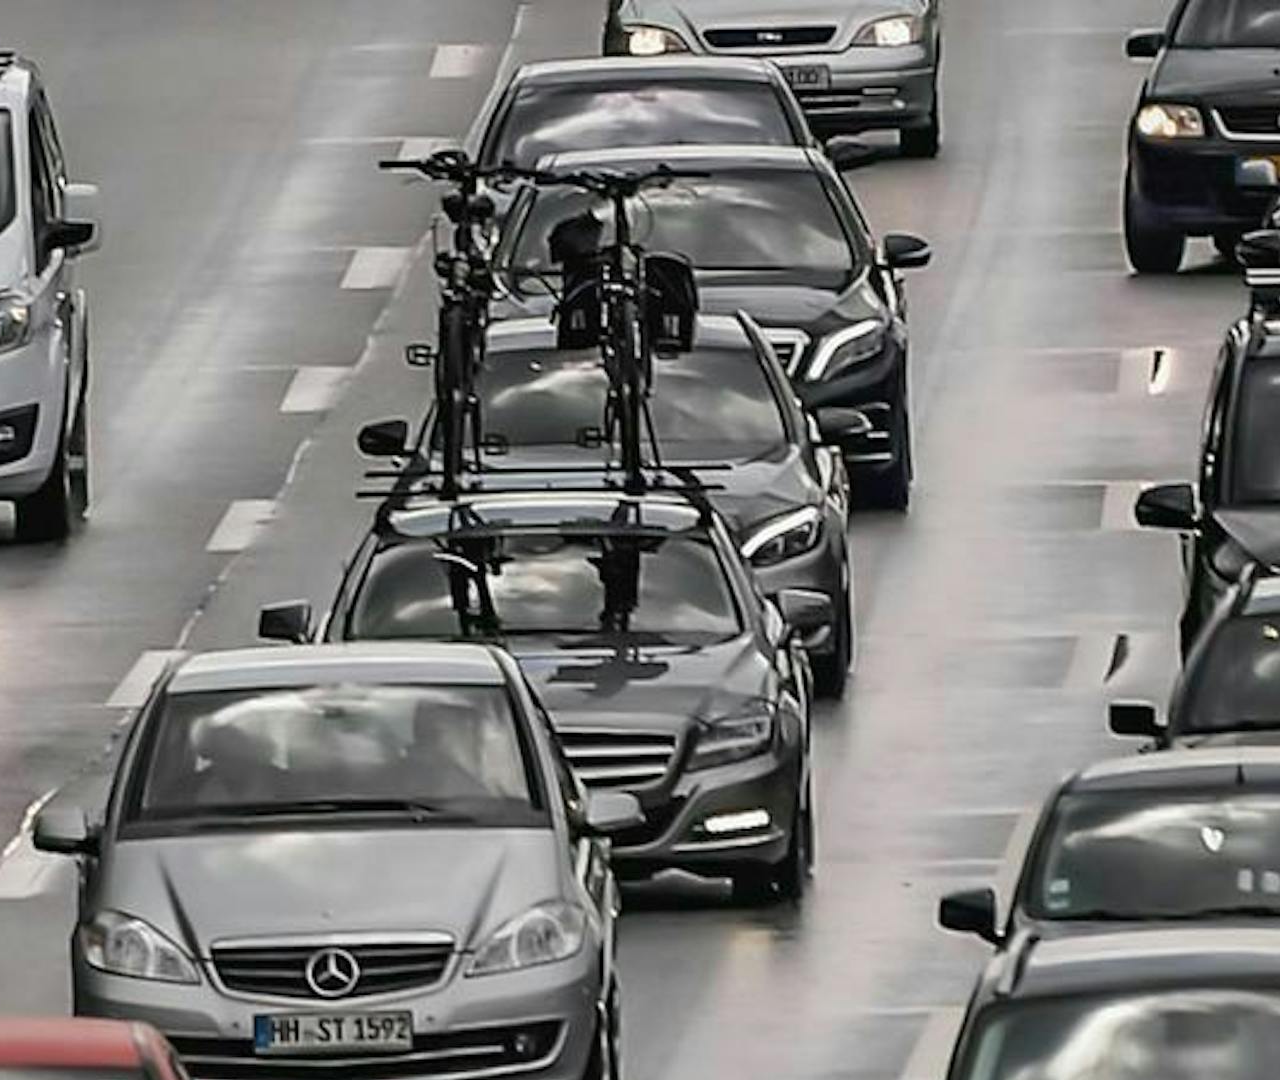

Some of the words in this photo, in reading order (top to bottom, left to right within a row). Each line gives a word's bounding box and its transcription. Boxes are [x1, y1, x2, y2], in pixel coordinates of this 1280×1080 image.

[271, 1019, 300, 1043] HH
[318, 1017, 344, 1042] ST
[354, 1015, 408, 1041] 1592
